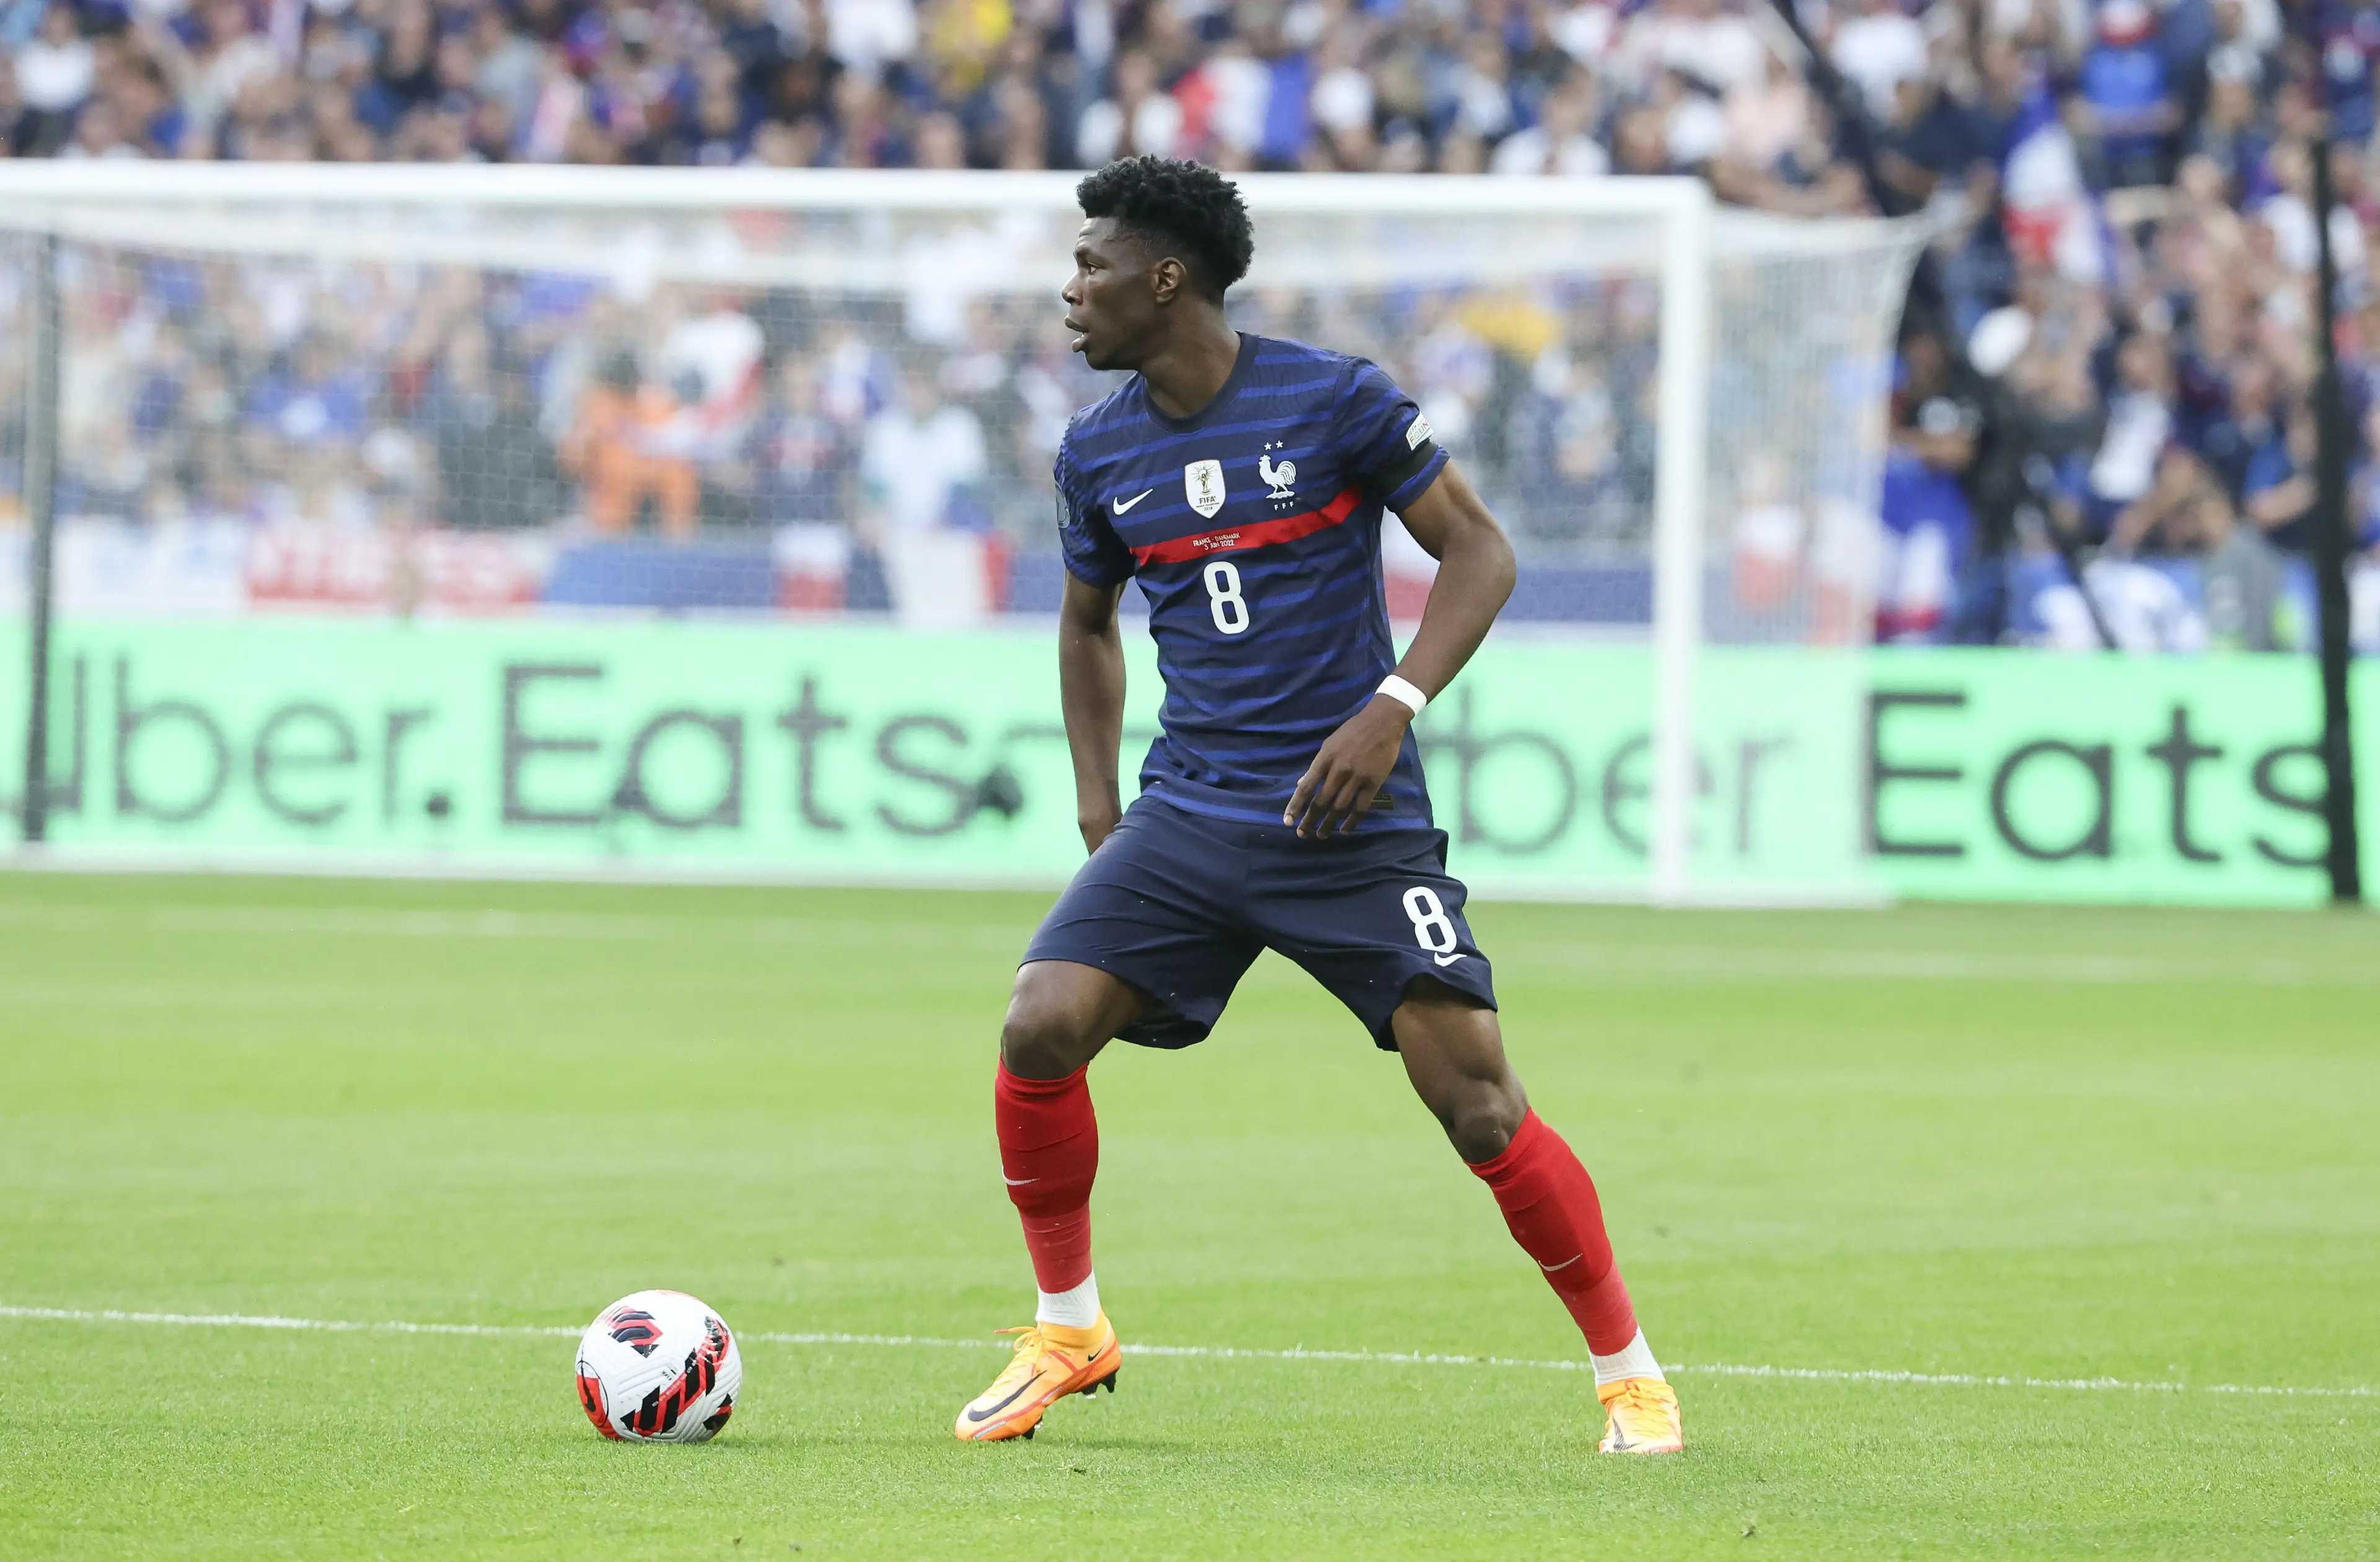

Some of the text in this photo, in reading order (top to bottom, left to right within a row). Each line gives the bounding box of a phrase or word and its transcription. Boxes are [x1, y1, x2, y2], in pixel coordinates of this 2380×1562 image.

[1192, 537, 1212, 547] FRANCE
[1215, 532, 1241, 542] DANEMARK
[1204, 561, 1250, 634] 8
[500, 663, 978, 838] Eats
[1867, 689, 2337, 869] Eats
[1402, 886, 1457, 953] 8
